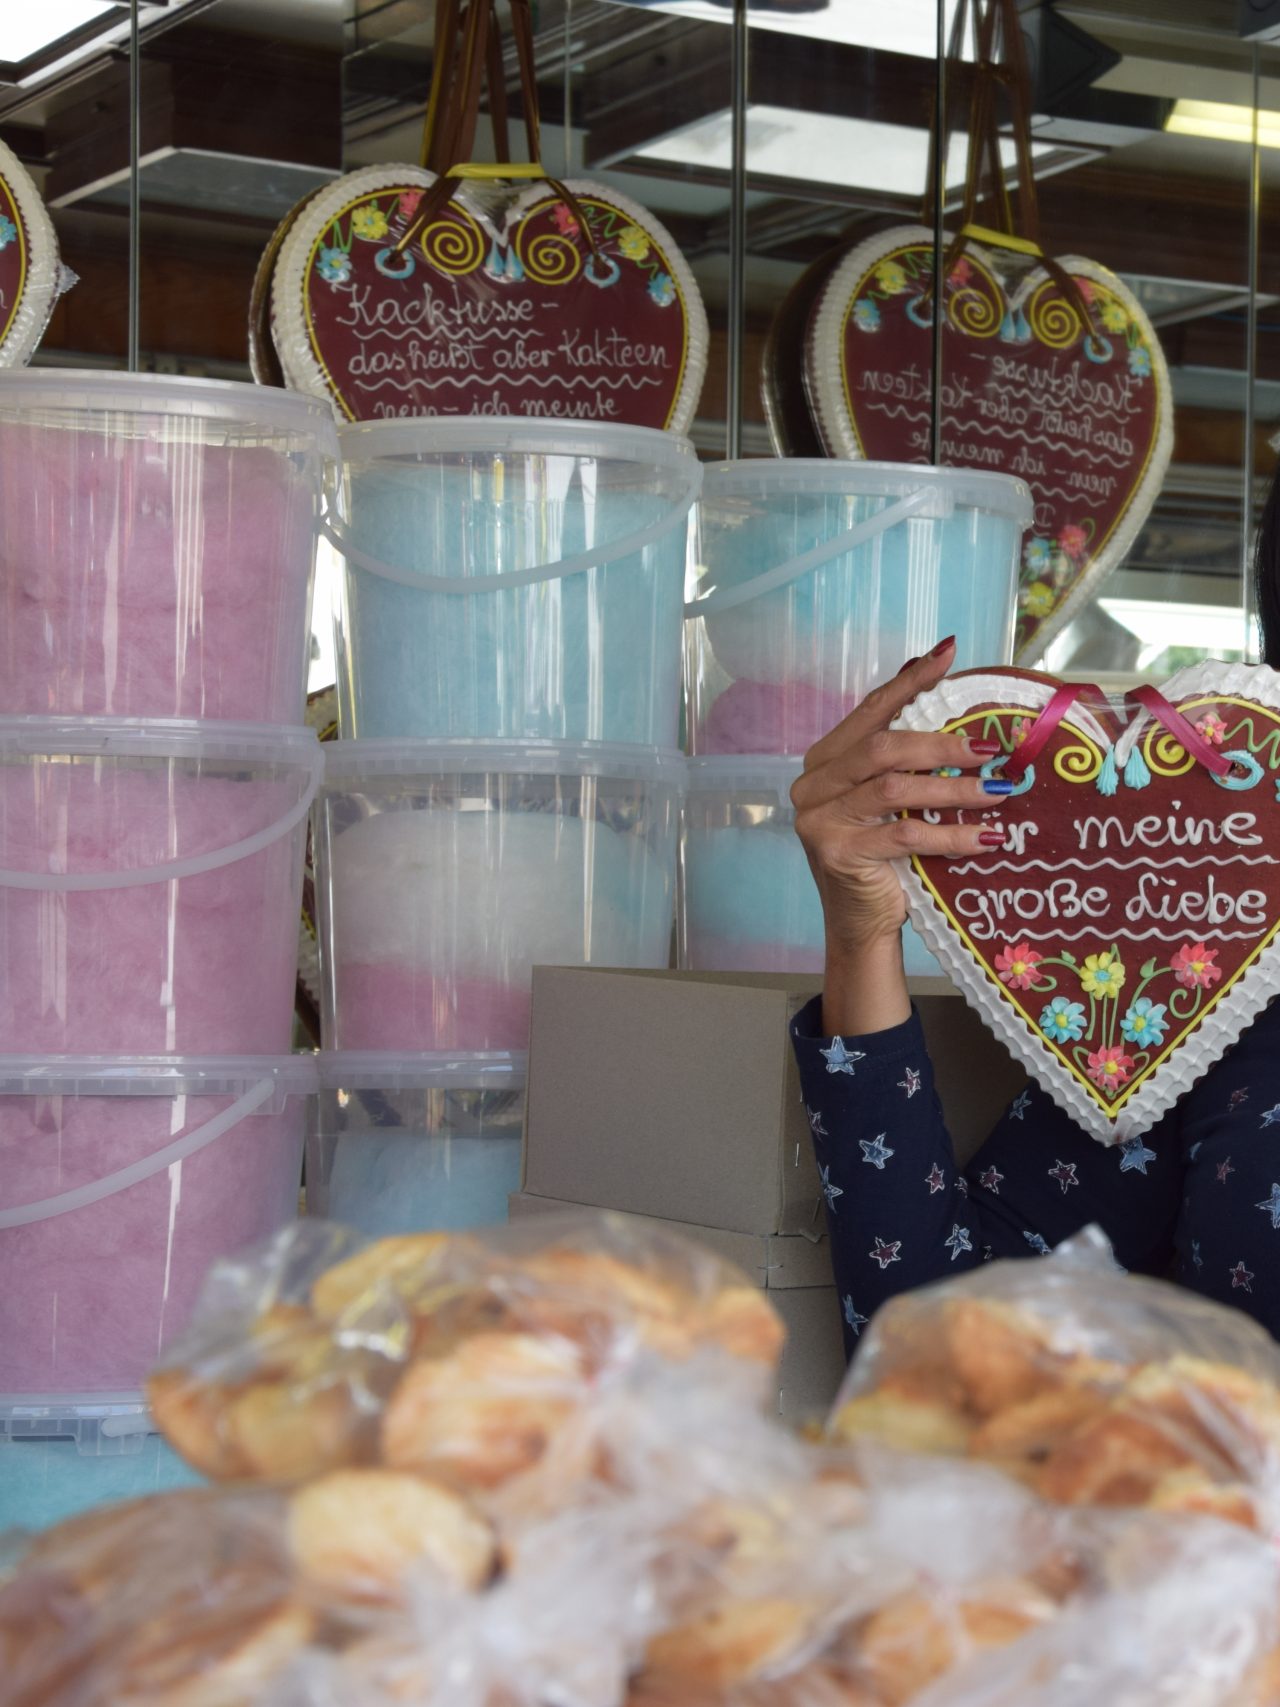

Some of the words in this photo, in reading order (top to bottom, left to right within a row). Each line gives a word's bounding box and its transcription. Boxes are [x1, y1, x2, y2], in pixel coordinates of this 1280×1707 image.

[406, 336, 486, 371] heißt
[491, 337, 556, 370] aber
[557, 326, 673, 370] Kakteen
[467, 390, 512, 418] ich
[519, 390, 621, 418] meinte
[1073, 800, 1264, 851] meine
[954, 878, 1112, 940] große
